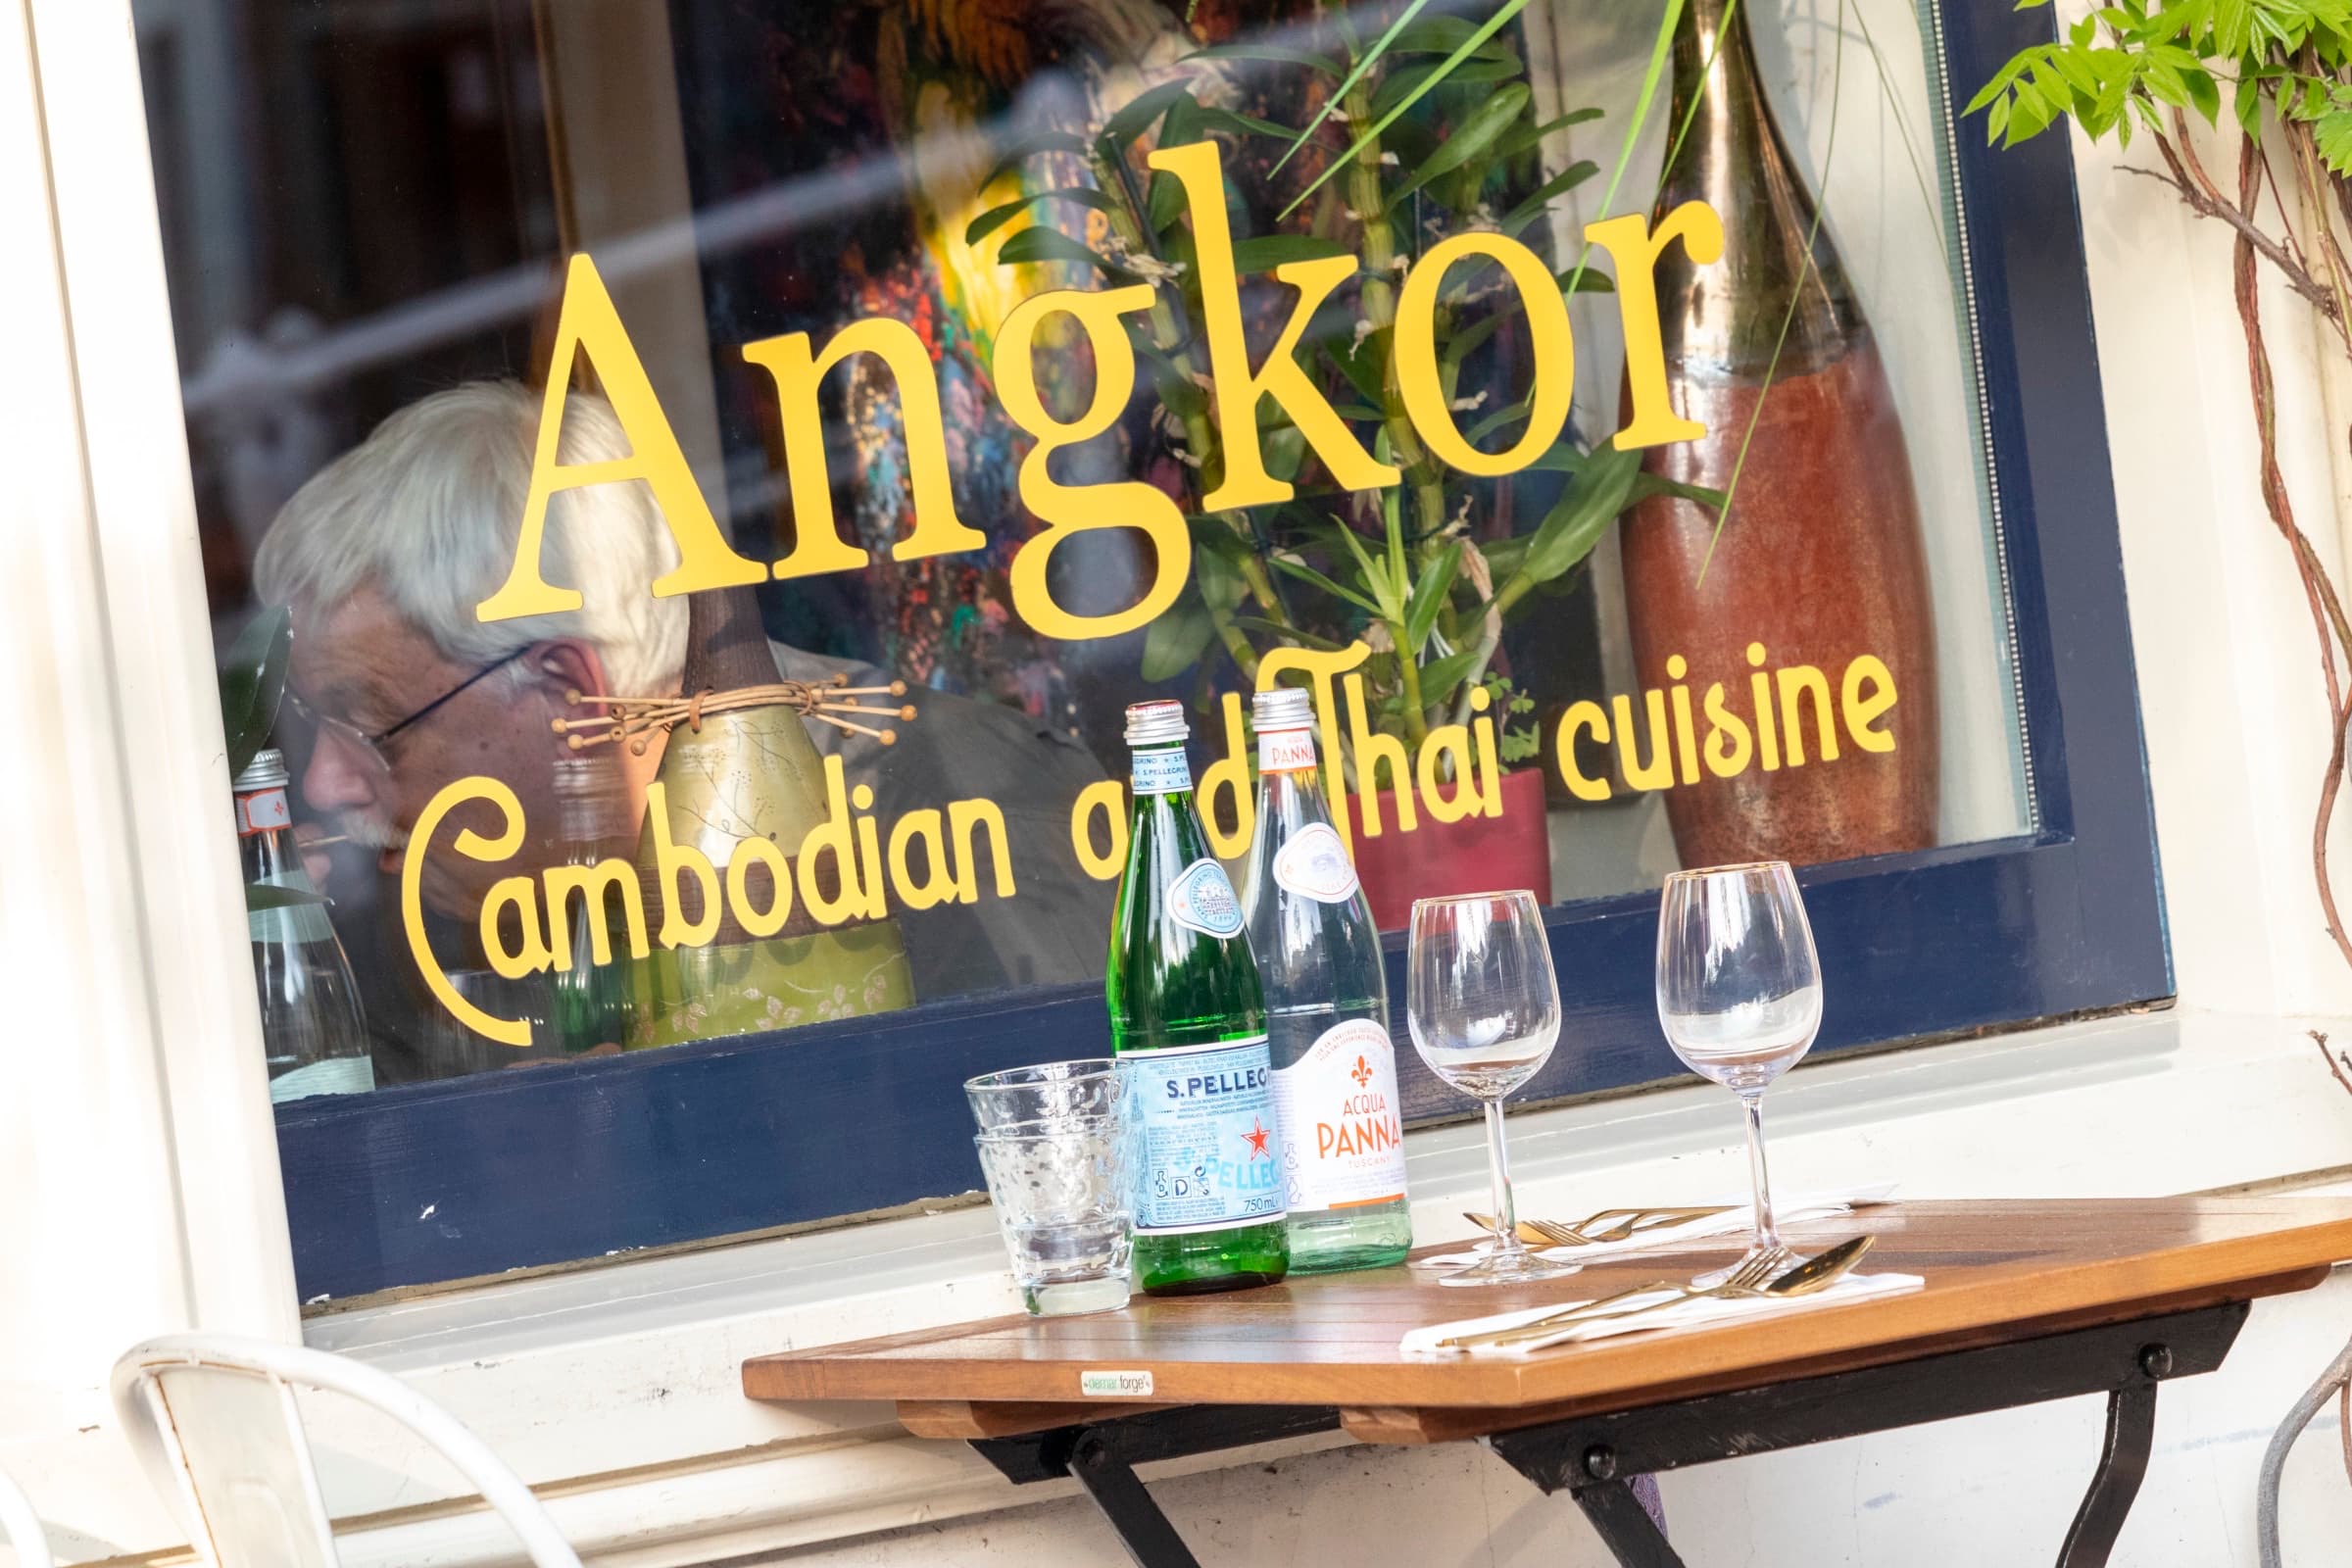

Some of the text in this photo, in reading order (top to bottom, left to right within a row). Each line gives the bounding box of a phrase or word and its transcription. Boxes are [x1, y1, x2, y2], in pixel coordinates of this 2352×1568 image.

[475, 141, 1726, 640] Angkor
[403, 639, 1899, 1046] Cambodian ad Thai cuisine
[1166, 1066, 1271, 1099] S.PELLEG
[1343, 1095, 1388, 1116] ACQUA
[1316, 1114, 1401, 1159] PANNA
